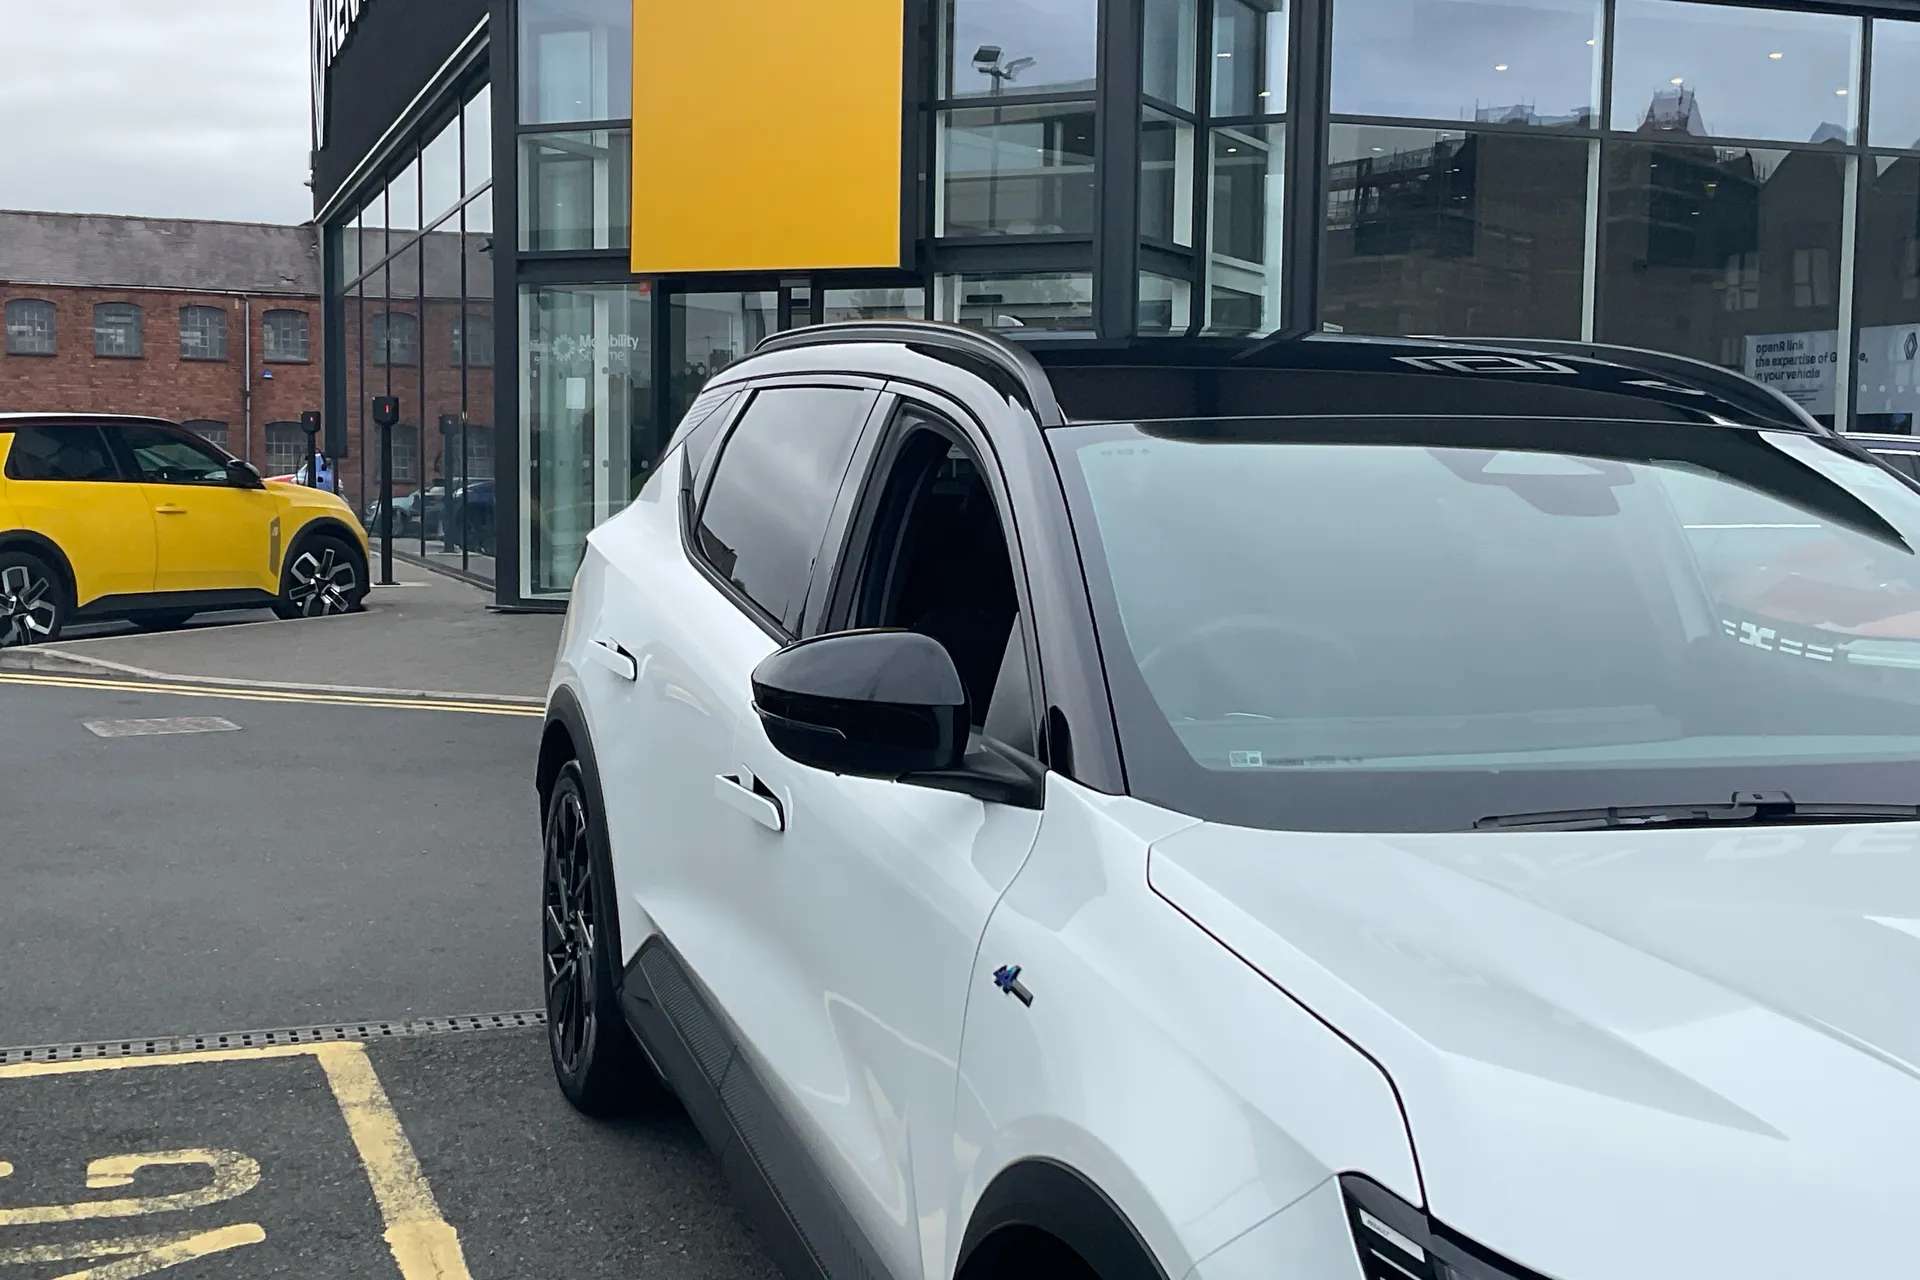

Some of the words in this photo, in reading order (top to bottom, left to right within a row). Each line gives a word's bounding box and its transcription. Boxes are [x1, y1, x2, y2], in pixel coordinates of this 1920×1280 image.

[580, 334, 638, 350] Mobility
[1787, 340, 1804, 351] link
[1756, 356, 1770, 367] the
[1772, 353, 1816, 368] expertise
[1818, 352, 1829, 364] of
[1763, 370, 1786, 383] your
[1786, 368, 1820, 380] vehicle
